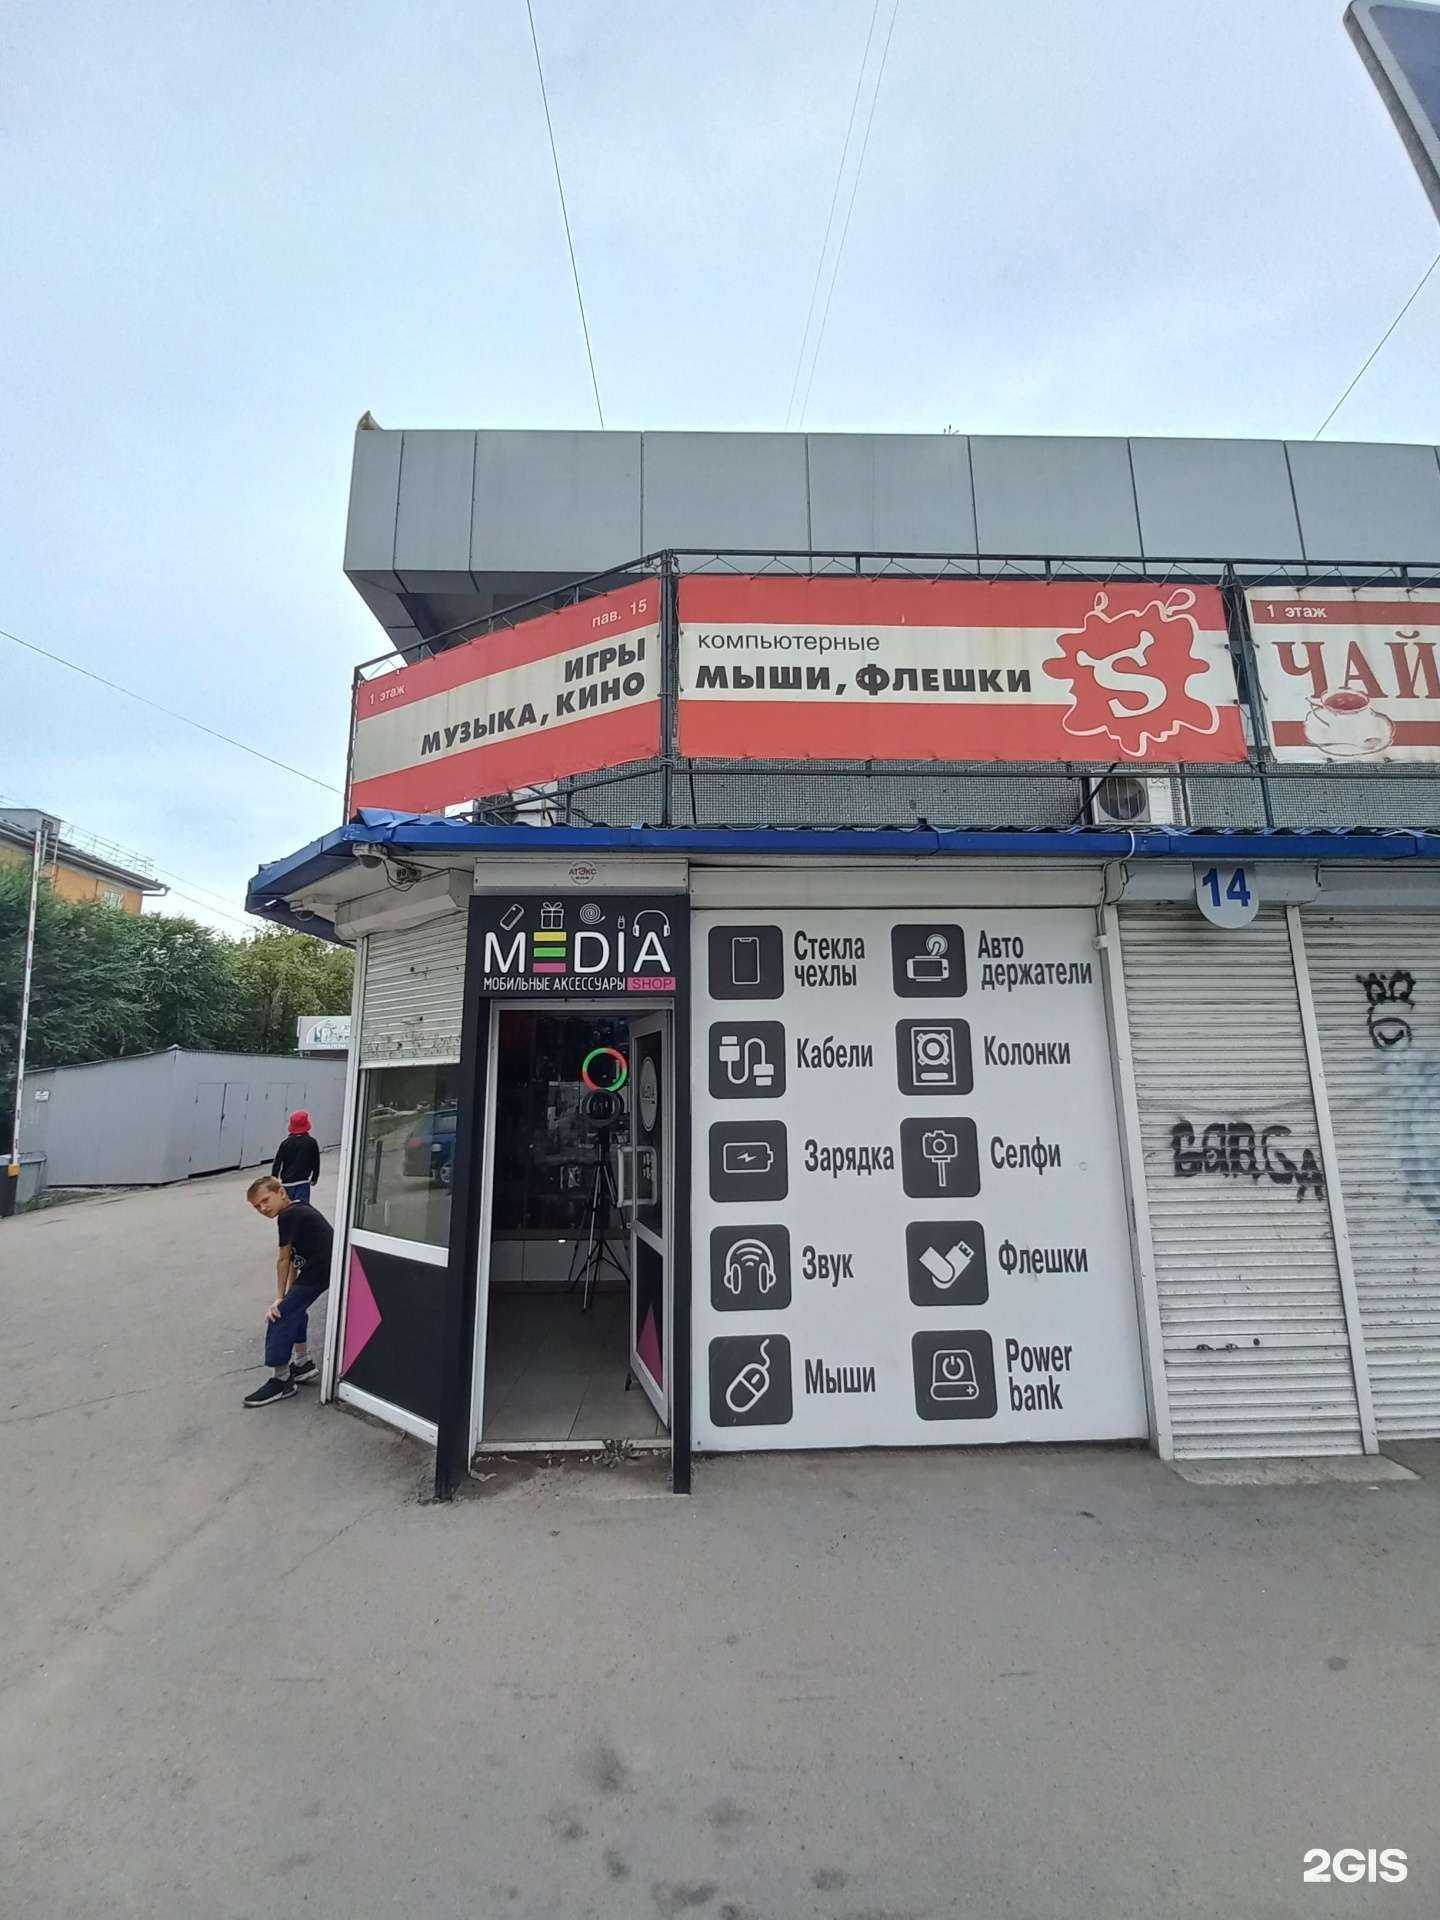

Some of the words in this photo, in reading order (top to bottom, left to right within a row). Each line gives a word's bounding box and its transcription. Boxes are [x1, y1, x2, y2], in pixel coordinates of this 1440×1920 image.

[592, 608, 622, 628] пав.
[629, 599, 648, 615] 15
[1265, 604, 1275, 618] 1
[1285, 604, 1327, 619] этаж
[564, 638, 646, 683] ИГРЫ
[698, 633, 880, 655] компьютерные
[856, 663, 1032, 696] ФЛЕШКИ
[1271, 630, 1440, 699] ЧАЙ
[379, 683, 406, 702] этаж
[420, 703, 550, 756] МУЗЫКА,
[556, 672, 646, 717] КИНО
[1202, 867, 1251, 907] 14
[483, 931, 671, 974] MEDIA
[793, 930, 865, 961] Стекла
[977, 930, 1025, 959] Авто
[483, 976, 551, 991] МОБИЛЬНЫЕ
[552, 976, 626, 991] АКСЕССУАРЫ
[631, 978, 674, 990] SHOP
[794, 962, 858, 988] чехлы
[981, 960, 1093, 992] держатели
[796, 1035, 874, 1069] Кабели
[983, 1035, 1072, 1066] Колонки
[804, 1138, 895, 1178] Зарядка
[990, 1135, 1063, 1175] Селфи
[801, 1244, 854, 1288] Звук
[998, 1238, 1089, 1275] Флешки
[1005, 1337, 1073, 1373] Power
[804, 1358, 877, 1395] Мыши
[1009, 1374, 1064, 1412] bank
